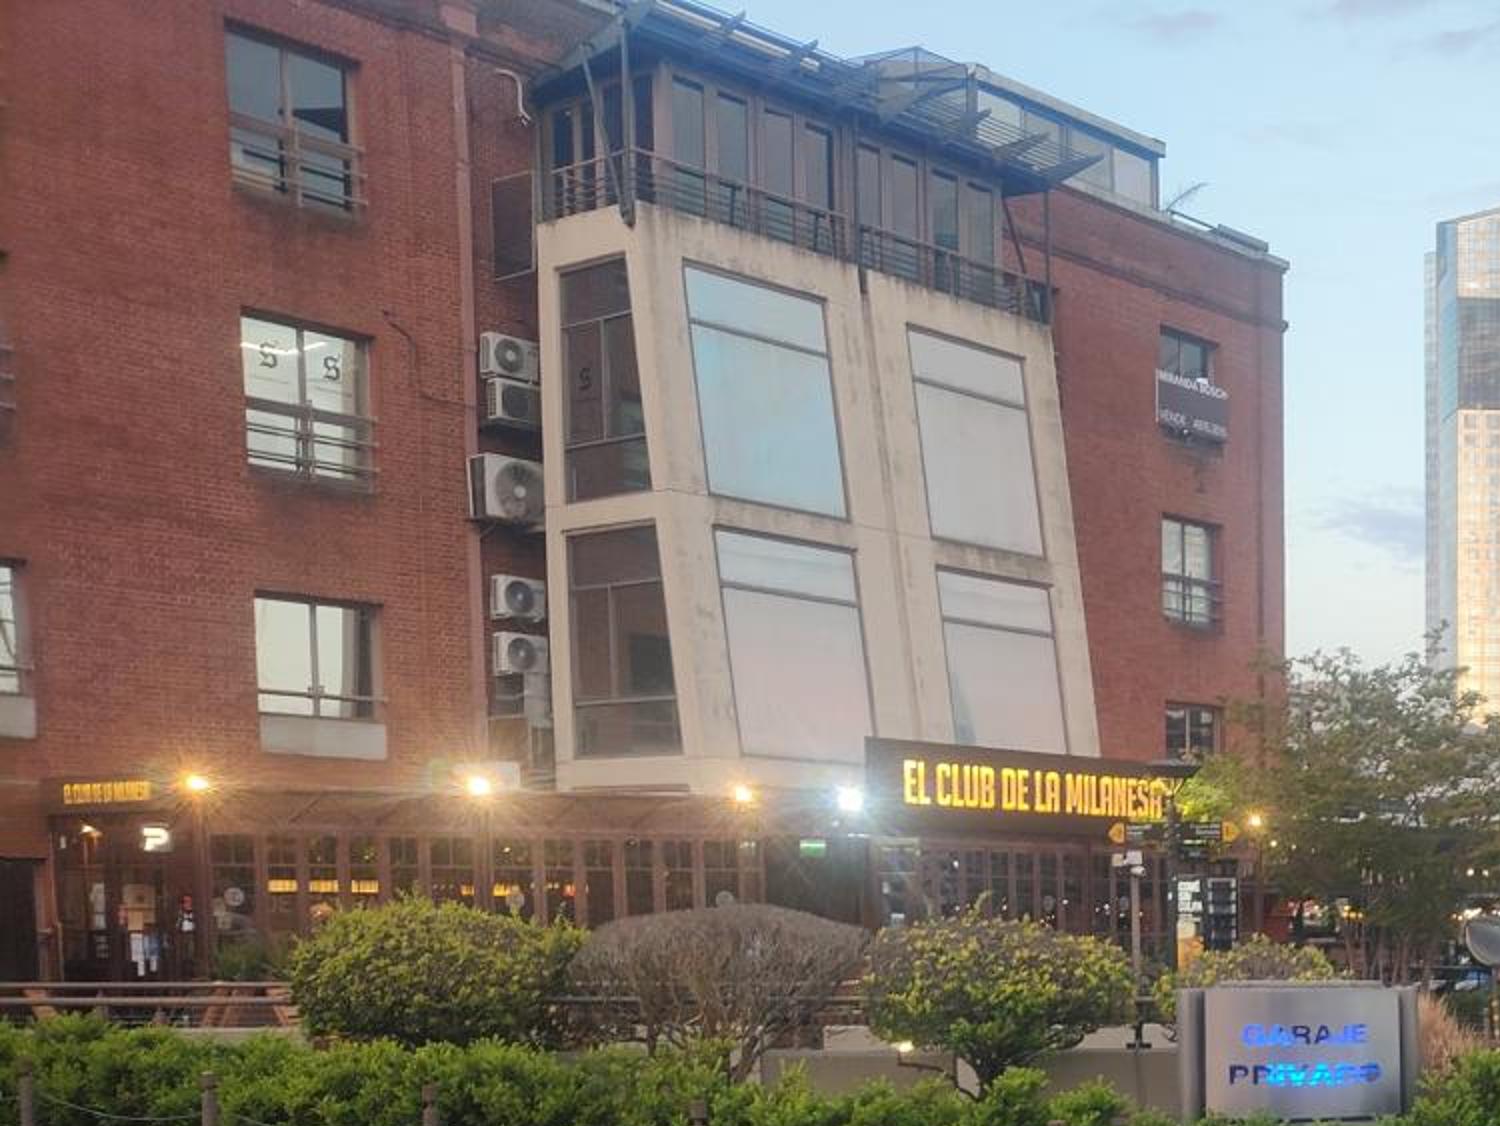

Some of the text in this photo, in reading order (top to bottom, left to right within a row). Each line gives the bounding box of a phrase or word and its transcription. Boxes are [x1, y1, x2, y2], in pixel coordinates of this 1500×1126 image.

[903, 759, 1164, 819] EL CLUB DE LA MILANESA
